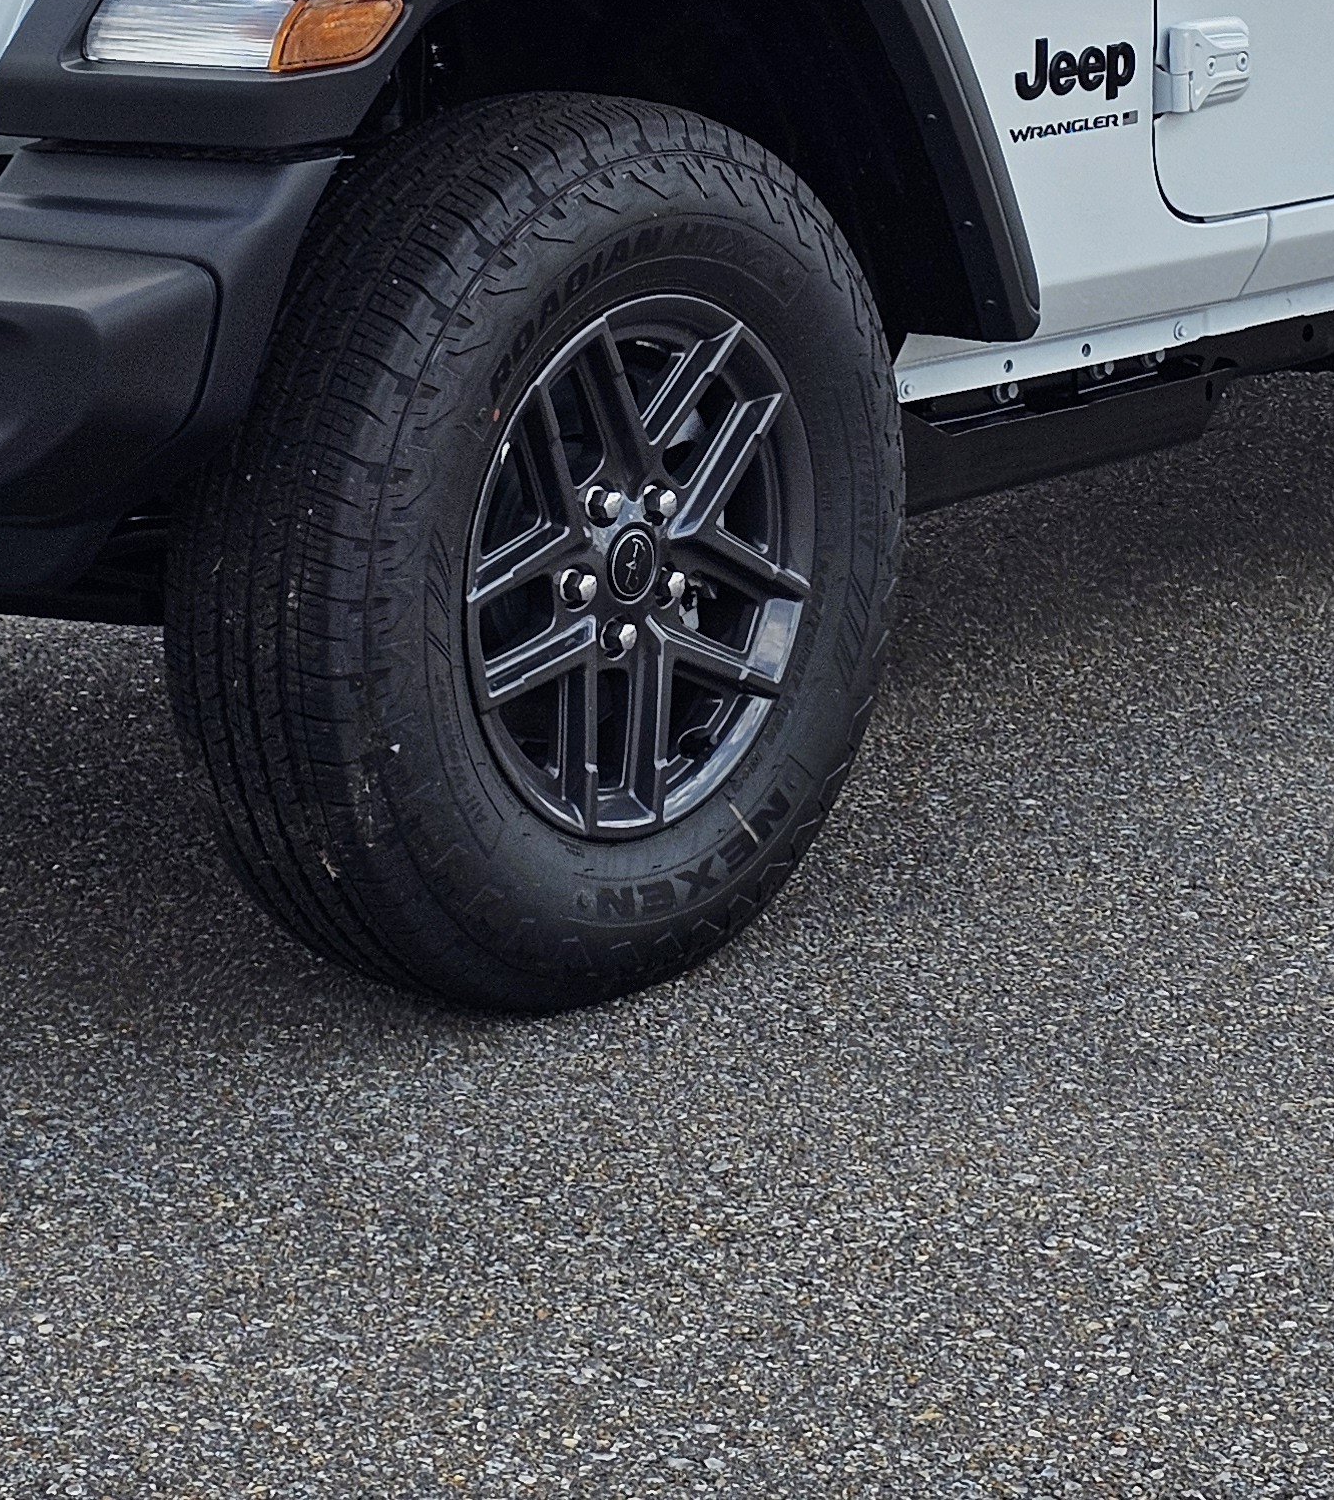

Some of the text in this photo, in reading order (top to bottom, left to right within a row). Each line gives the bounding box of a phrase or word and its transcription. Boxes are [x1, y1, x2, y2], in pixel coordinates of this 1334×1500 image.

[1014, 37, 1136, 101] Jeep
[1009, 113, 1119, 144] WRANGLER
[596, 786, 791, 917] NEXEN
